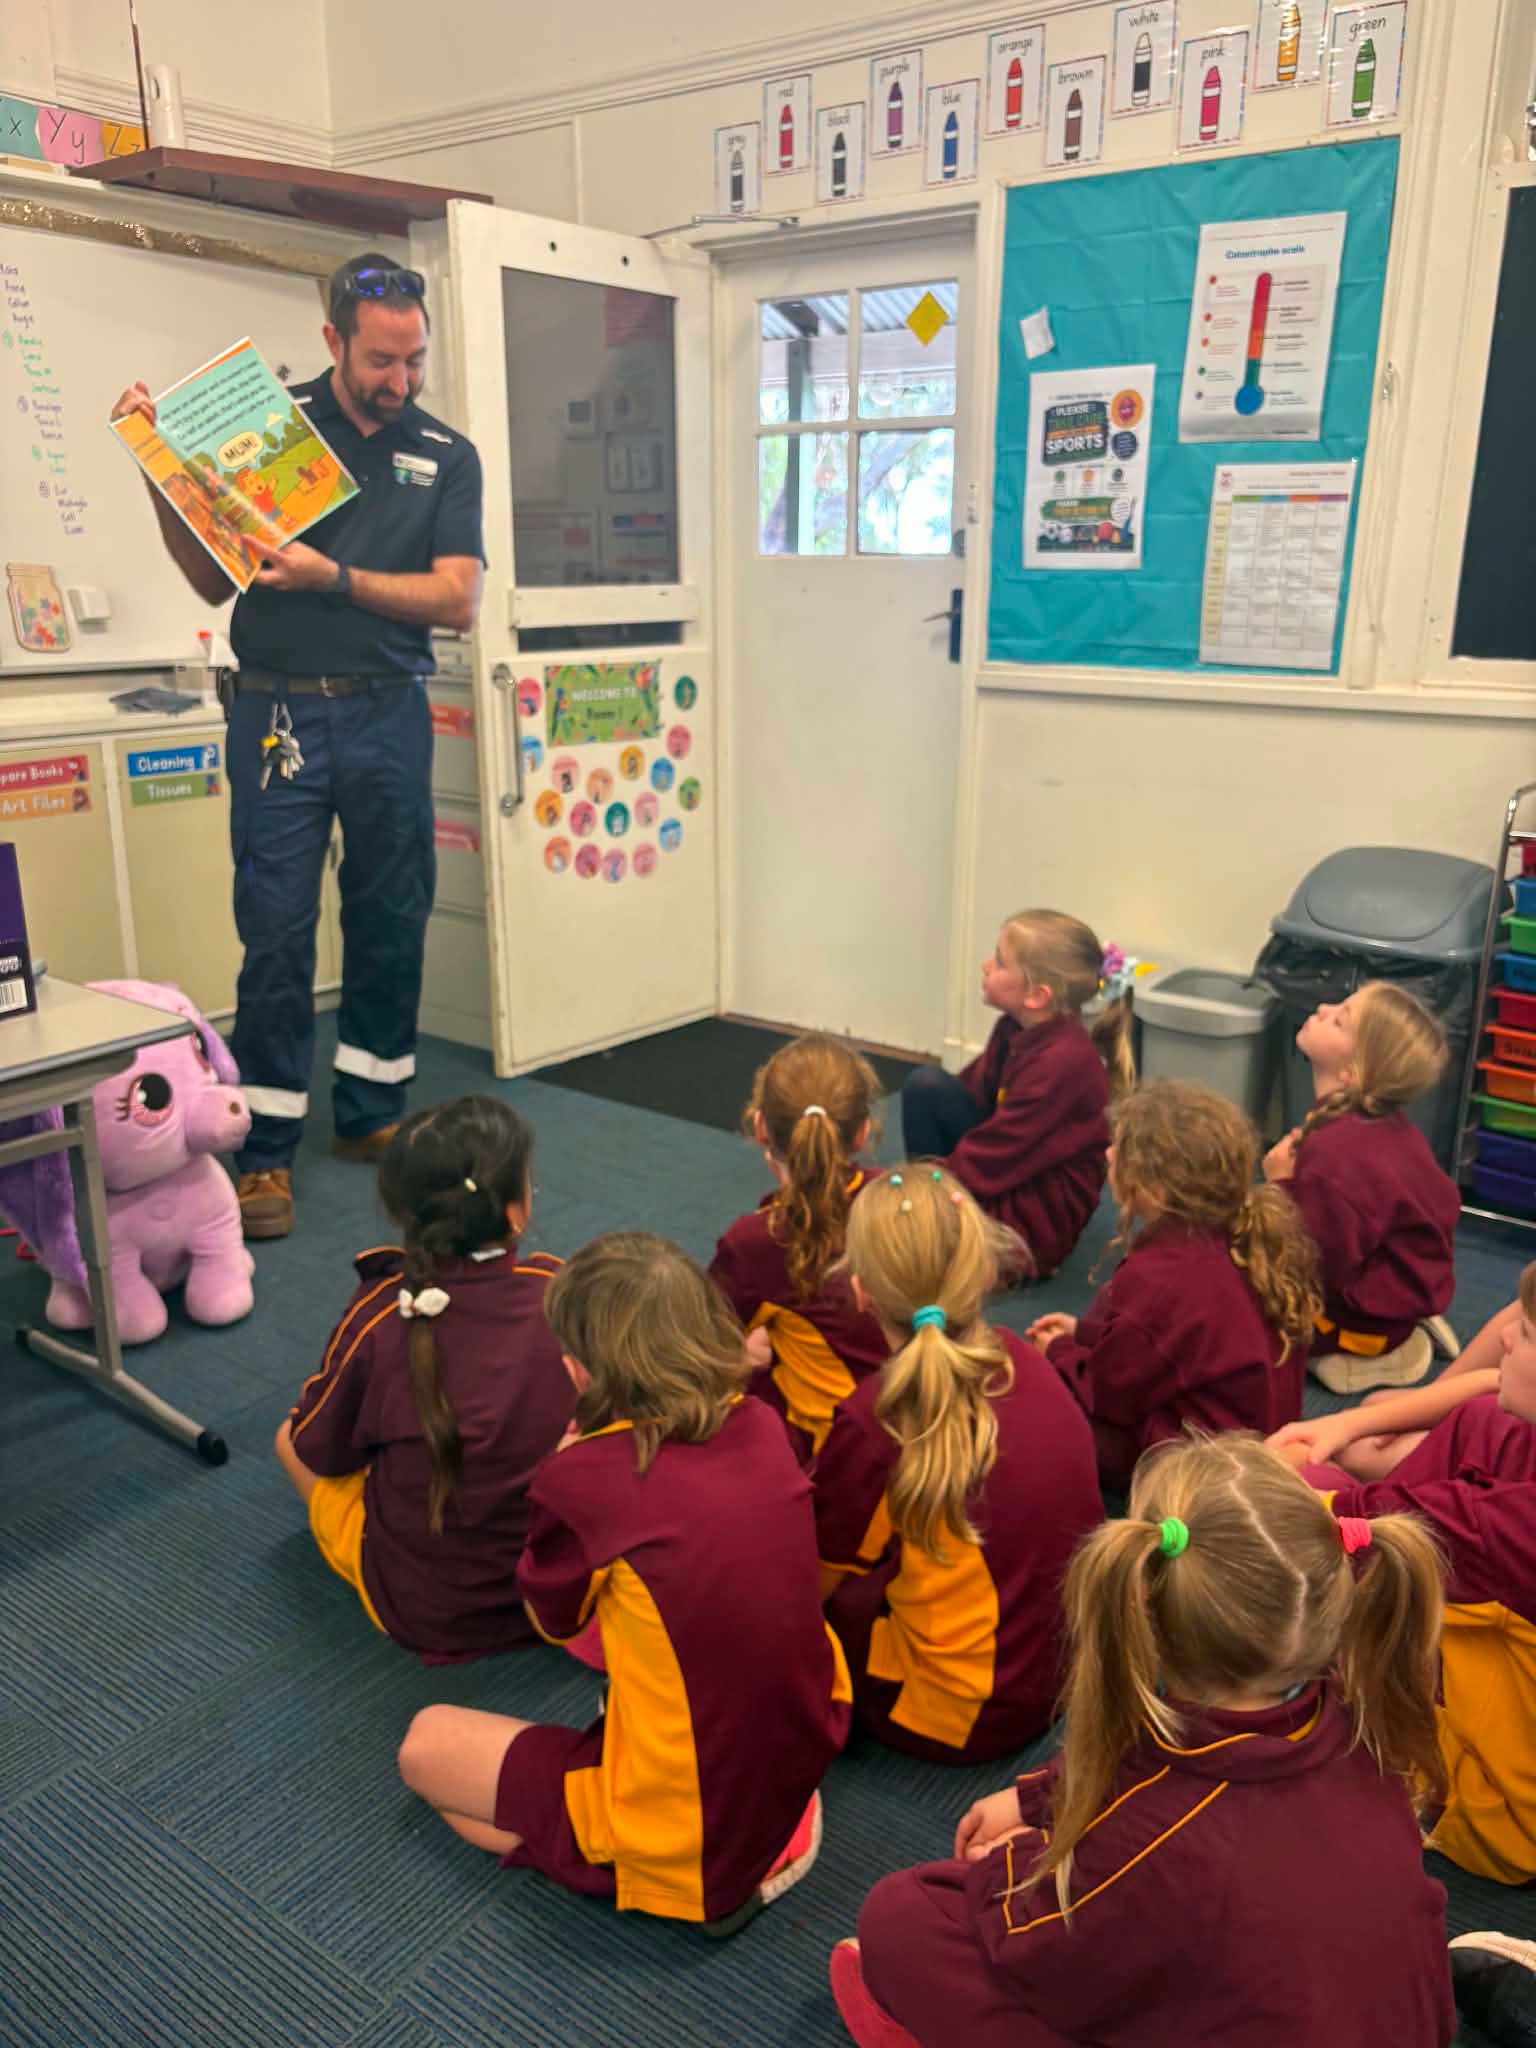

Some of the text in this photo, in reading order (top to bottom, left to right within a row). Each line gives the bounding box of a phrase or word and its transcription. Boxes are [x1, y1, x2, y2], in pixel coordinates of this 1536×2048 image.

[1129, 8, 1159, 27] white
[1349, 17, 1386, 41] green
[997, 38, 1033, 56] orange
[1200, 39, 1225, 67] pink
[1058, 69, 1094, 84] brown
[1047, 433, 1104, 454] SPORTS
[137, 755, 195, 771] Cleaning
[0, 770, 27, 787] pare
[146, 783, 192, 799] Tissues
